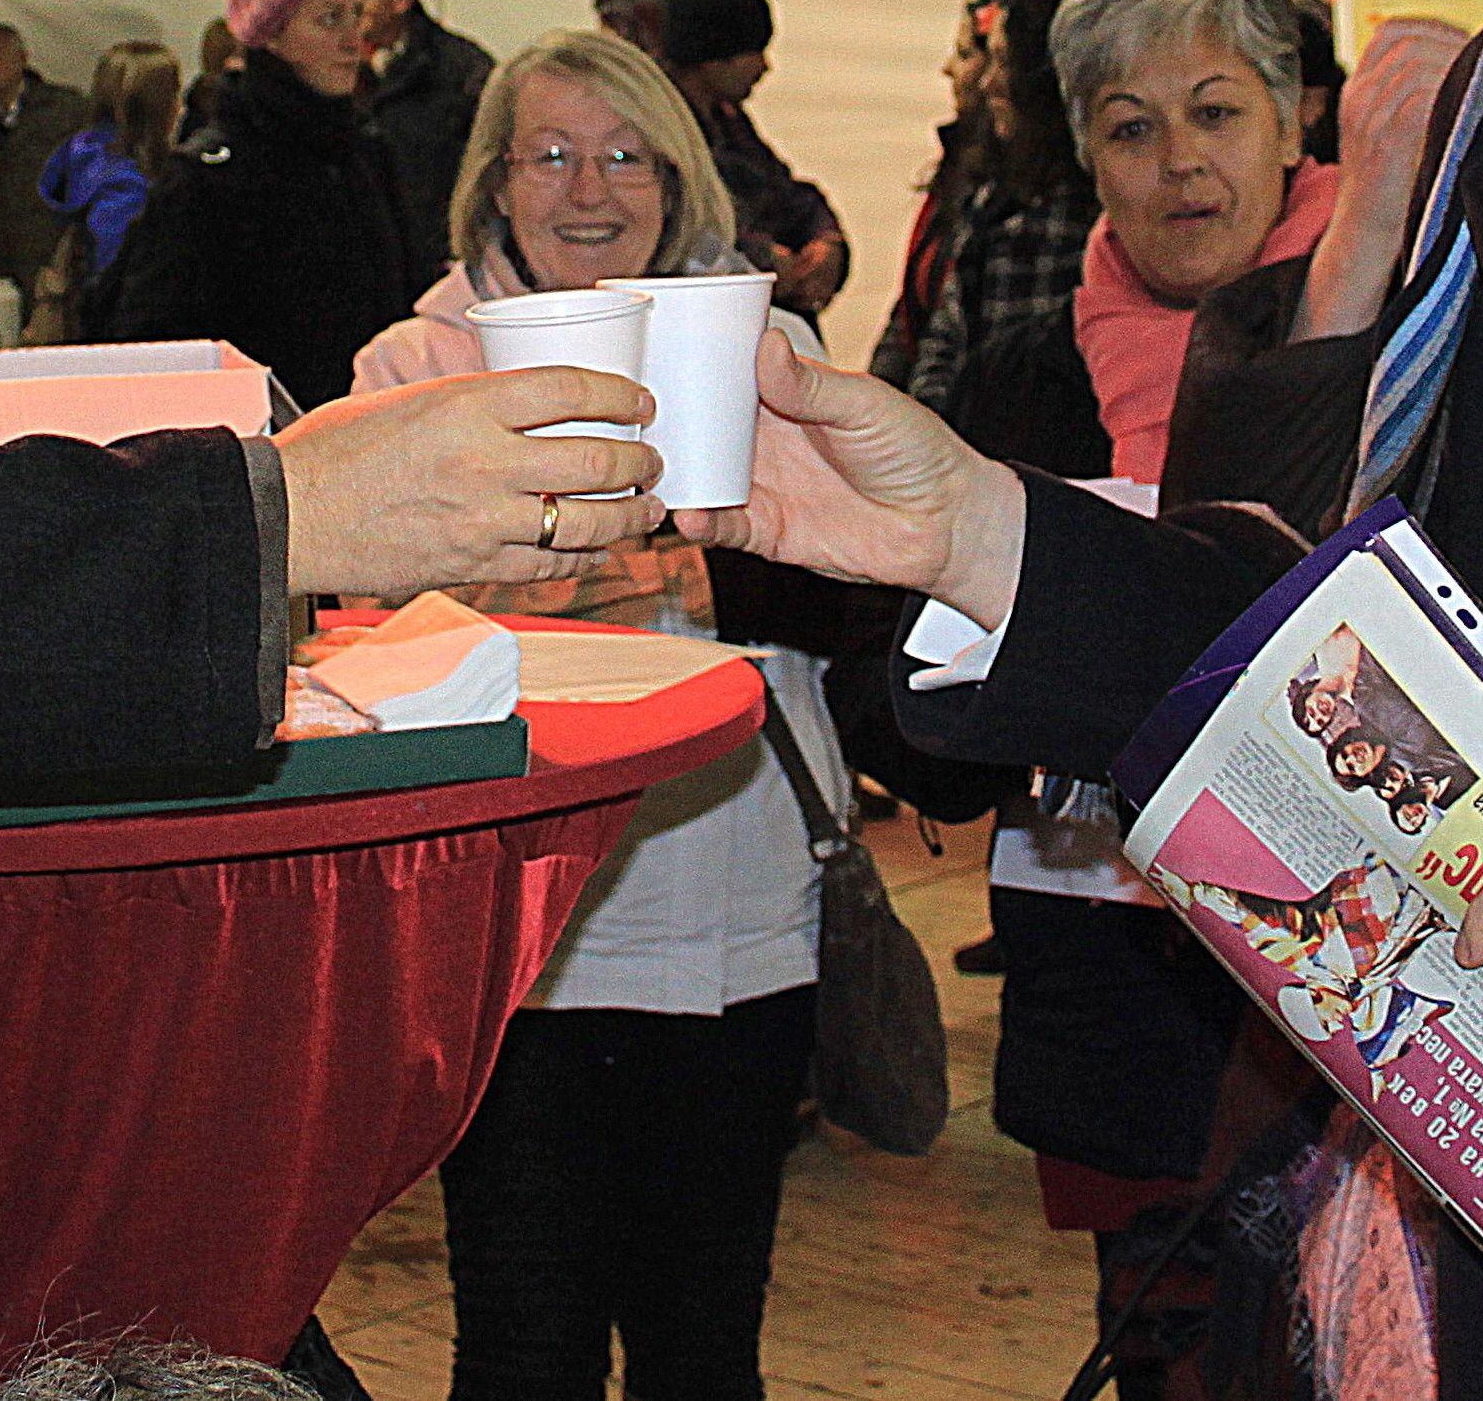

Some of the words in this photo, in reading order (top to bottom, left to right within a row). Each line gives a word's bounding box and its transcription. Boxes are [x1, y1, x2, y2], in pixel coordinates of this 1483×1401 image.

[1386, 1072, 1428, 1117] век
[1432, 1075, 1451, 1105] 1,
[1447, 1096, 1476, 1129] №
[1426, 1115, 1460, 1149] 20
